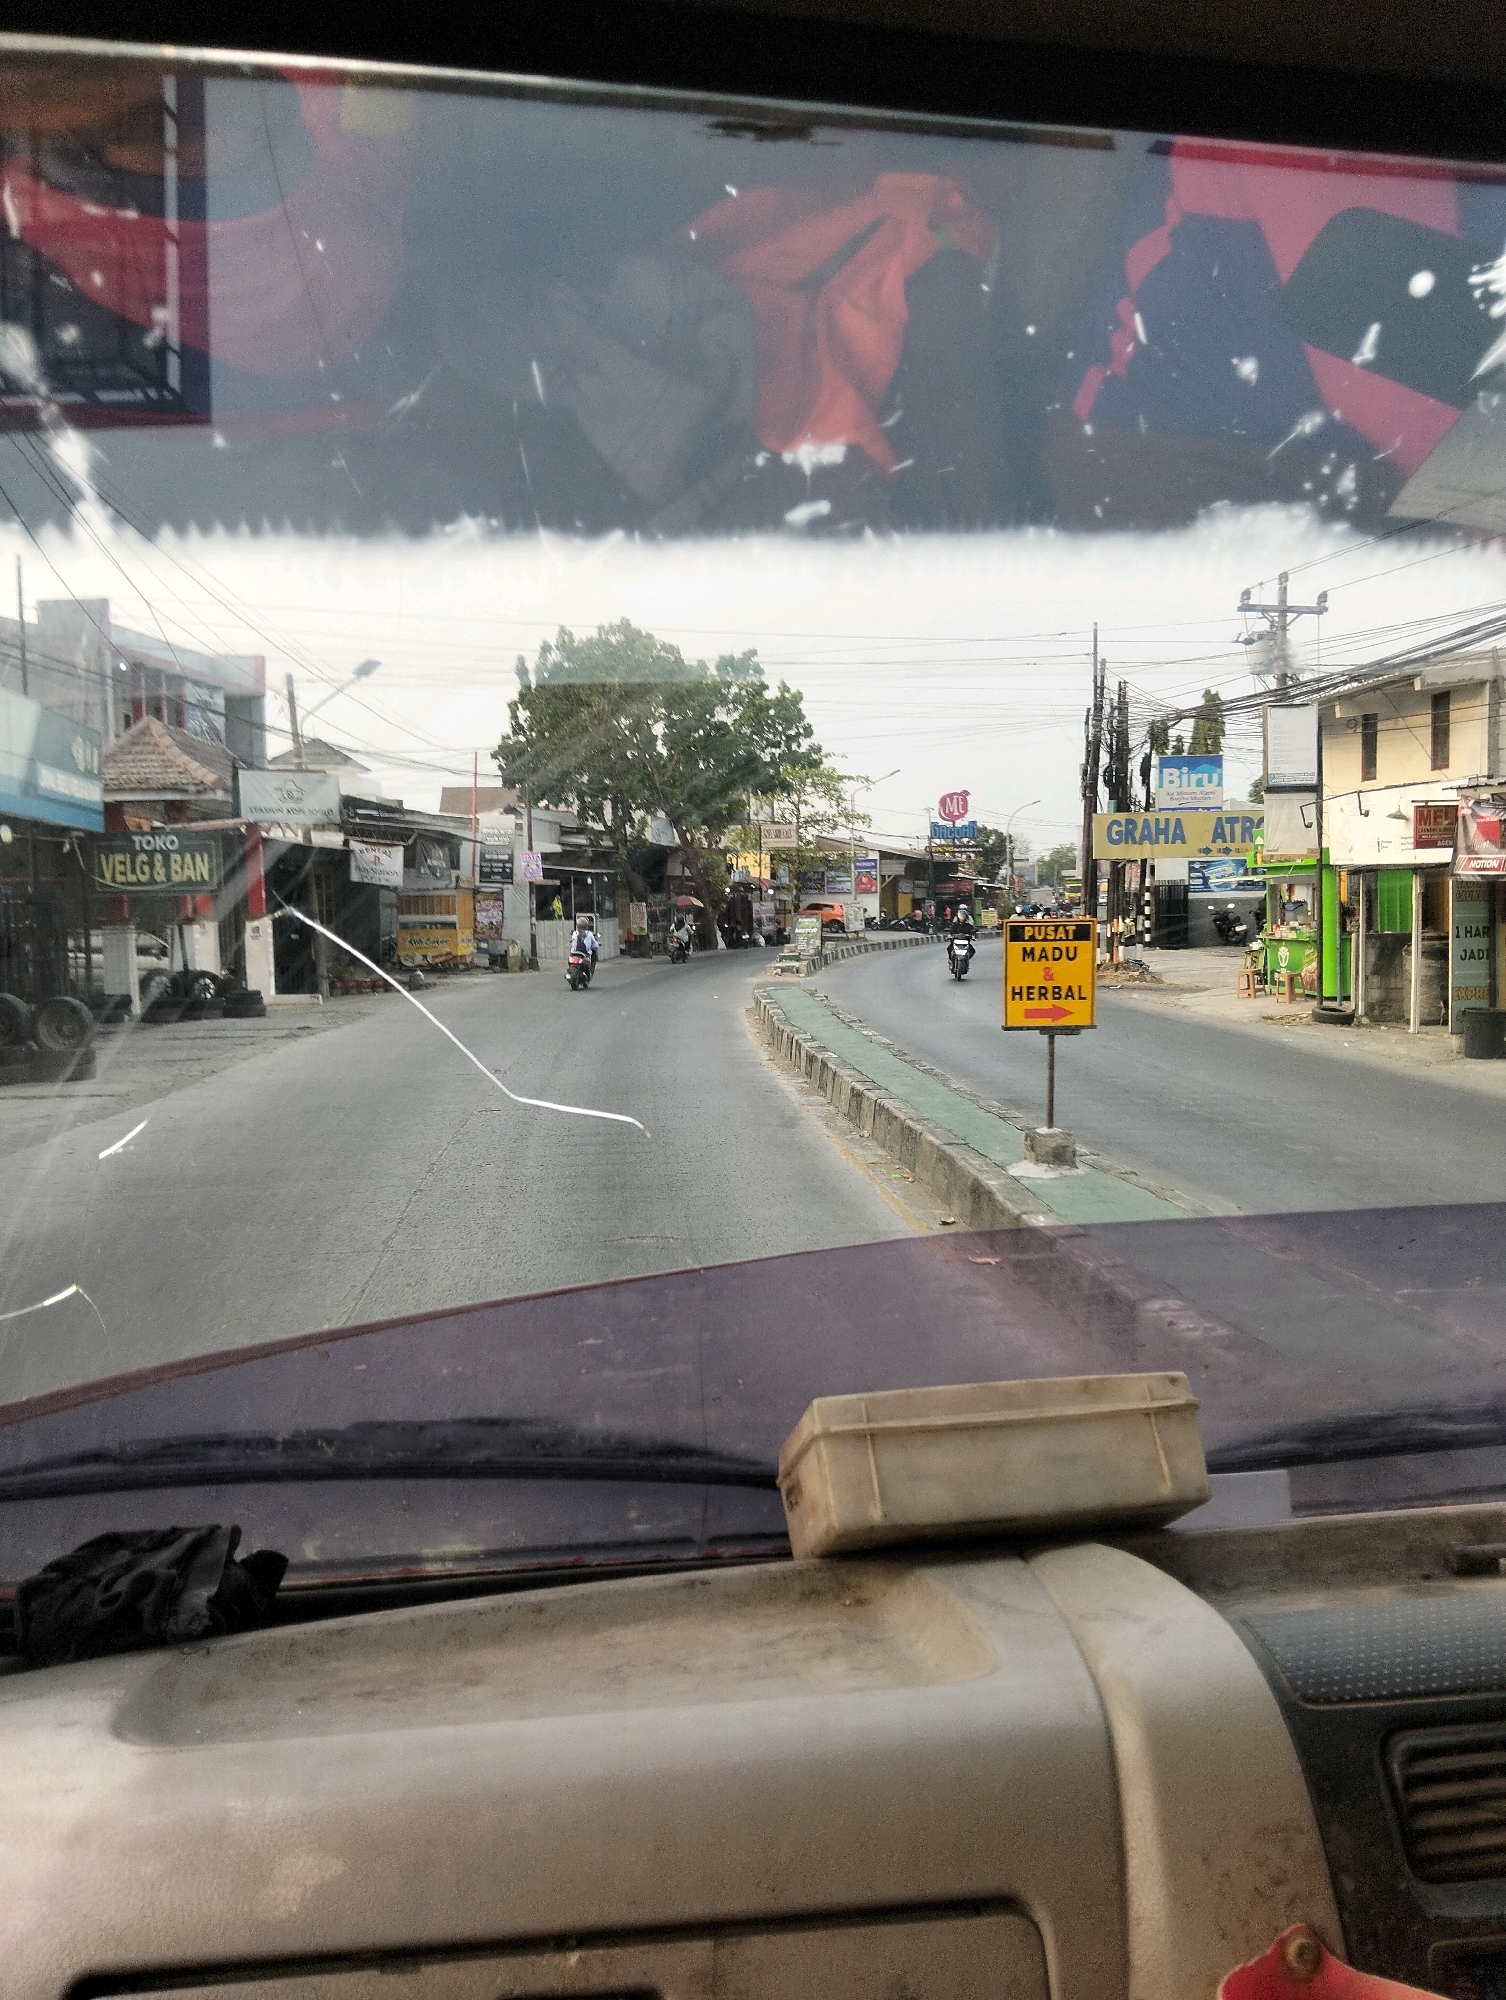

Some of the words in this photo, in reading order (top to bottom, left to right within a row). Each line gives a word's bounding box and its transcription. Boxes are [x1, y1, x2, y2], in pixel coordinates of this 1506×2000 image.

[1163, 766, 1219, 788] Biru
[931, 821, 978, 839] GACOAN
[1106, 818, 1187, 845] GRAHA
[132, 834, 179, 851] TOKO
[100, 852, 151, 883] VELG
[153, 852, 168, 882] &
[170, 852, 209, 882] BAN
[1469, 860, 1500, 869] MOTION
[1024, 926, 1076, 940] PUSAT
[1022, 946, 1077, 962] MADU
[1042, 966, 1054, 981] &
[1011, 985, 1087, 1001] HERBAL
[1452, 986, 1490, 1001] EXPRE
